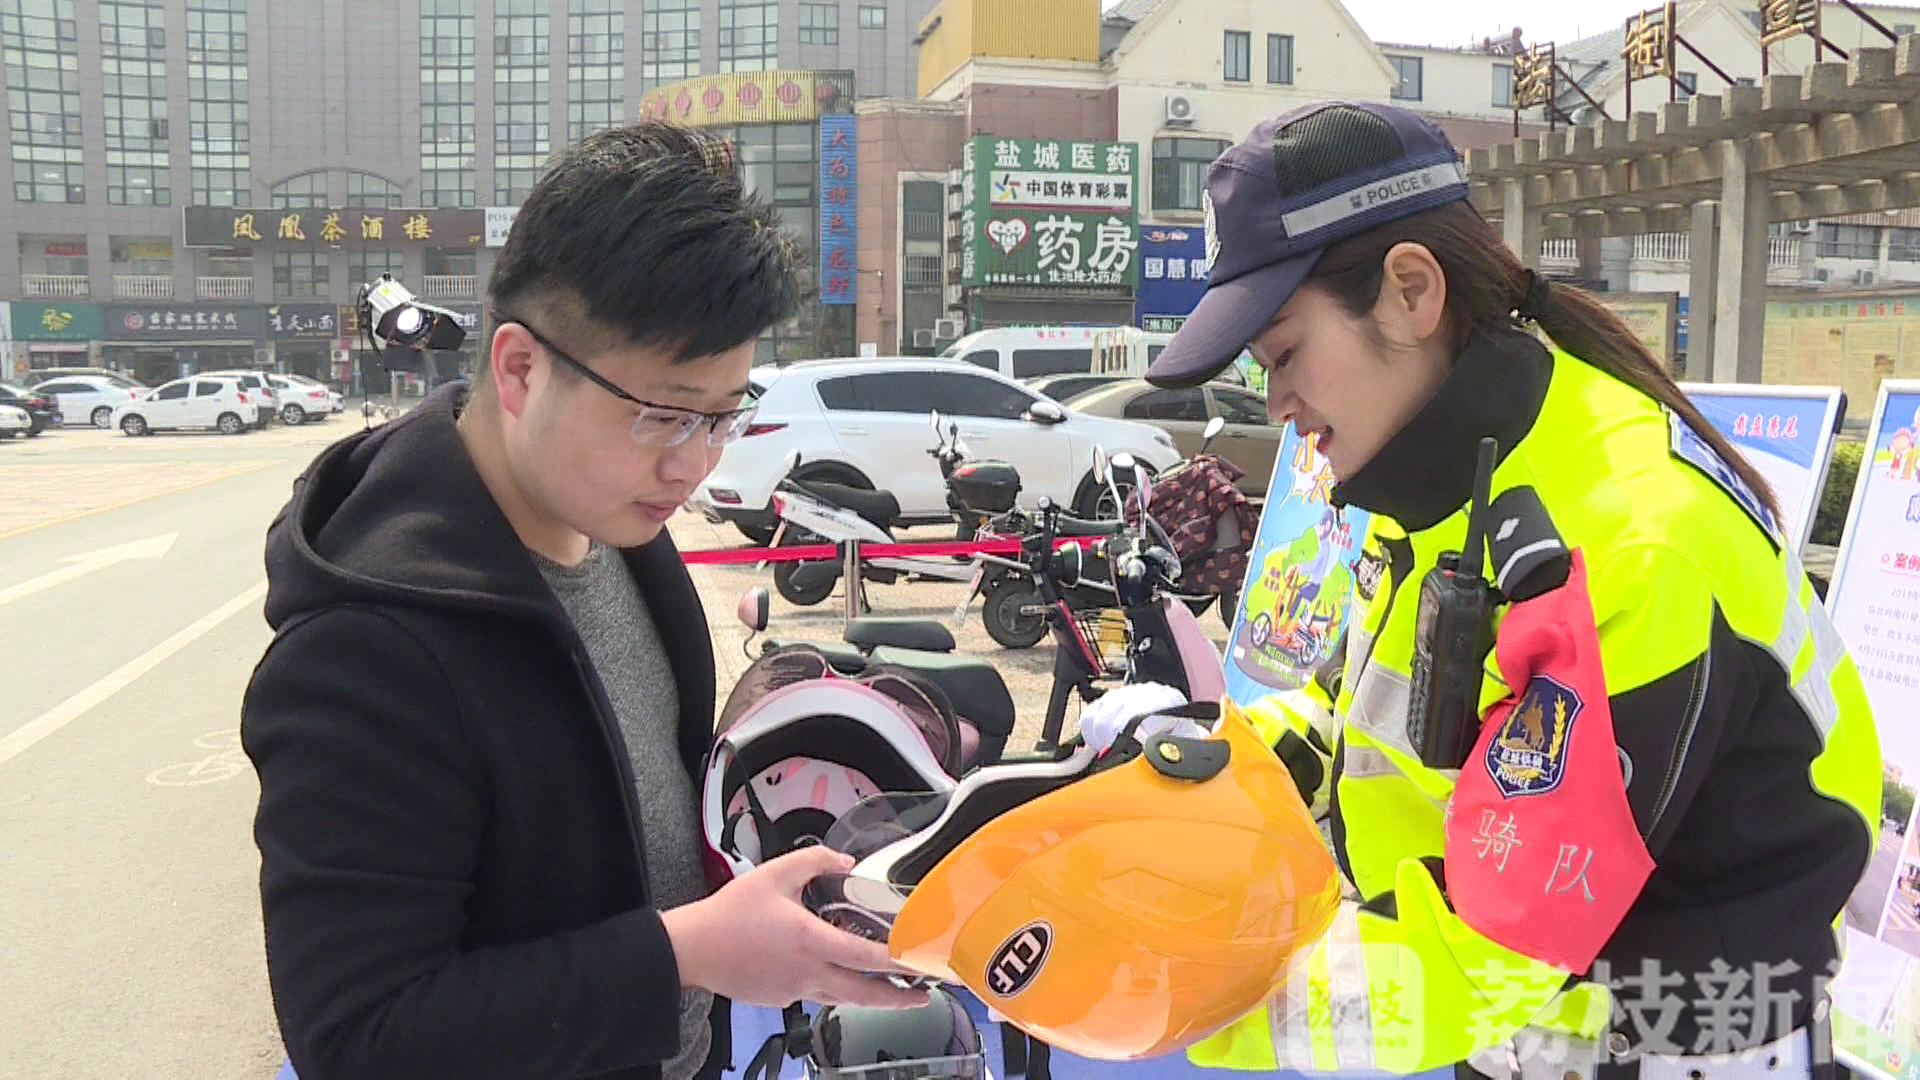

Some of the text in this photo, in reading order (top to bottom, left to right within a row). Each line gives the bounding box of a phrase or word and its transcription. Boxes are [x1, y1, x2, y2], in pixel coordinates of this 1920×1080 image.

[994, 140, 1132, 173] 盐城医药
[1027, 179, 1129, 201] 中国体育彩票
[1366, 176, 1422, 204] POLICE
[233, 213, 434, 241] 凤凰茶酒楼
[1035, 214, 1139, 273] 药房
[993, 931, 1043, 994] CLF
